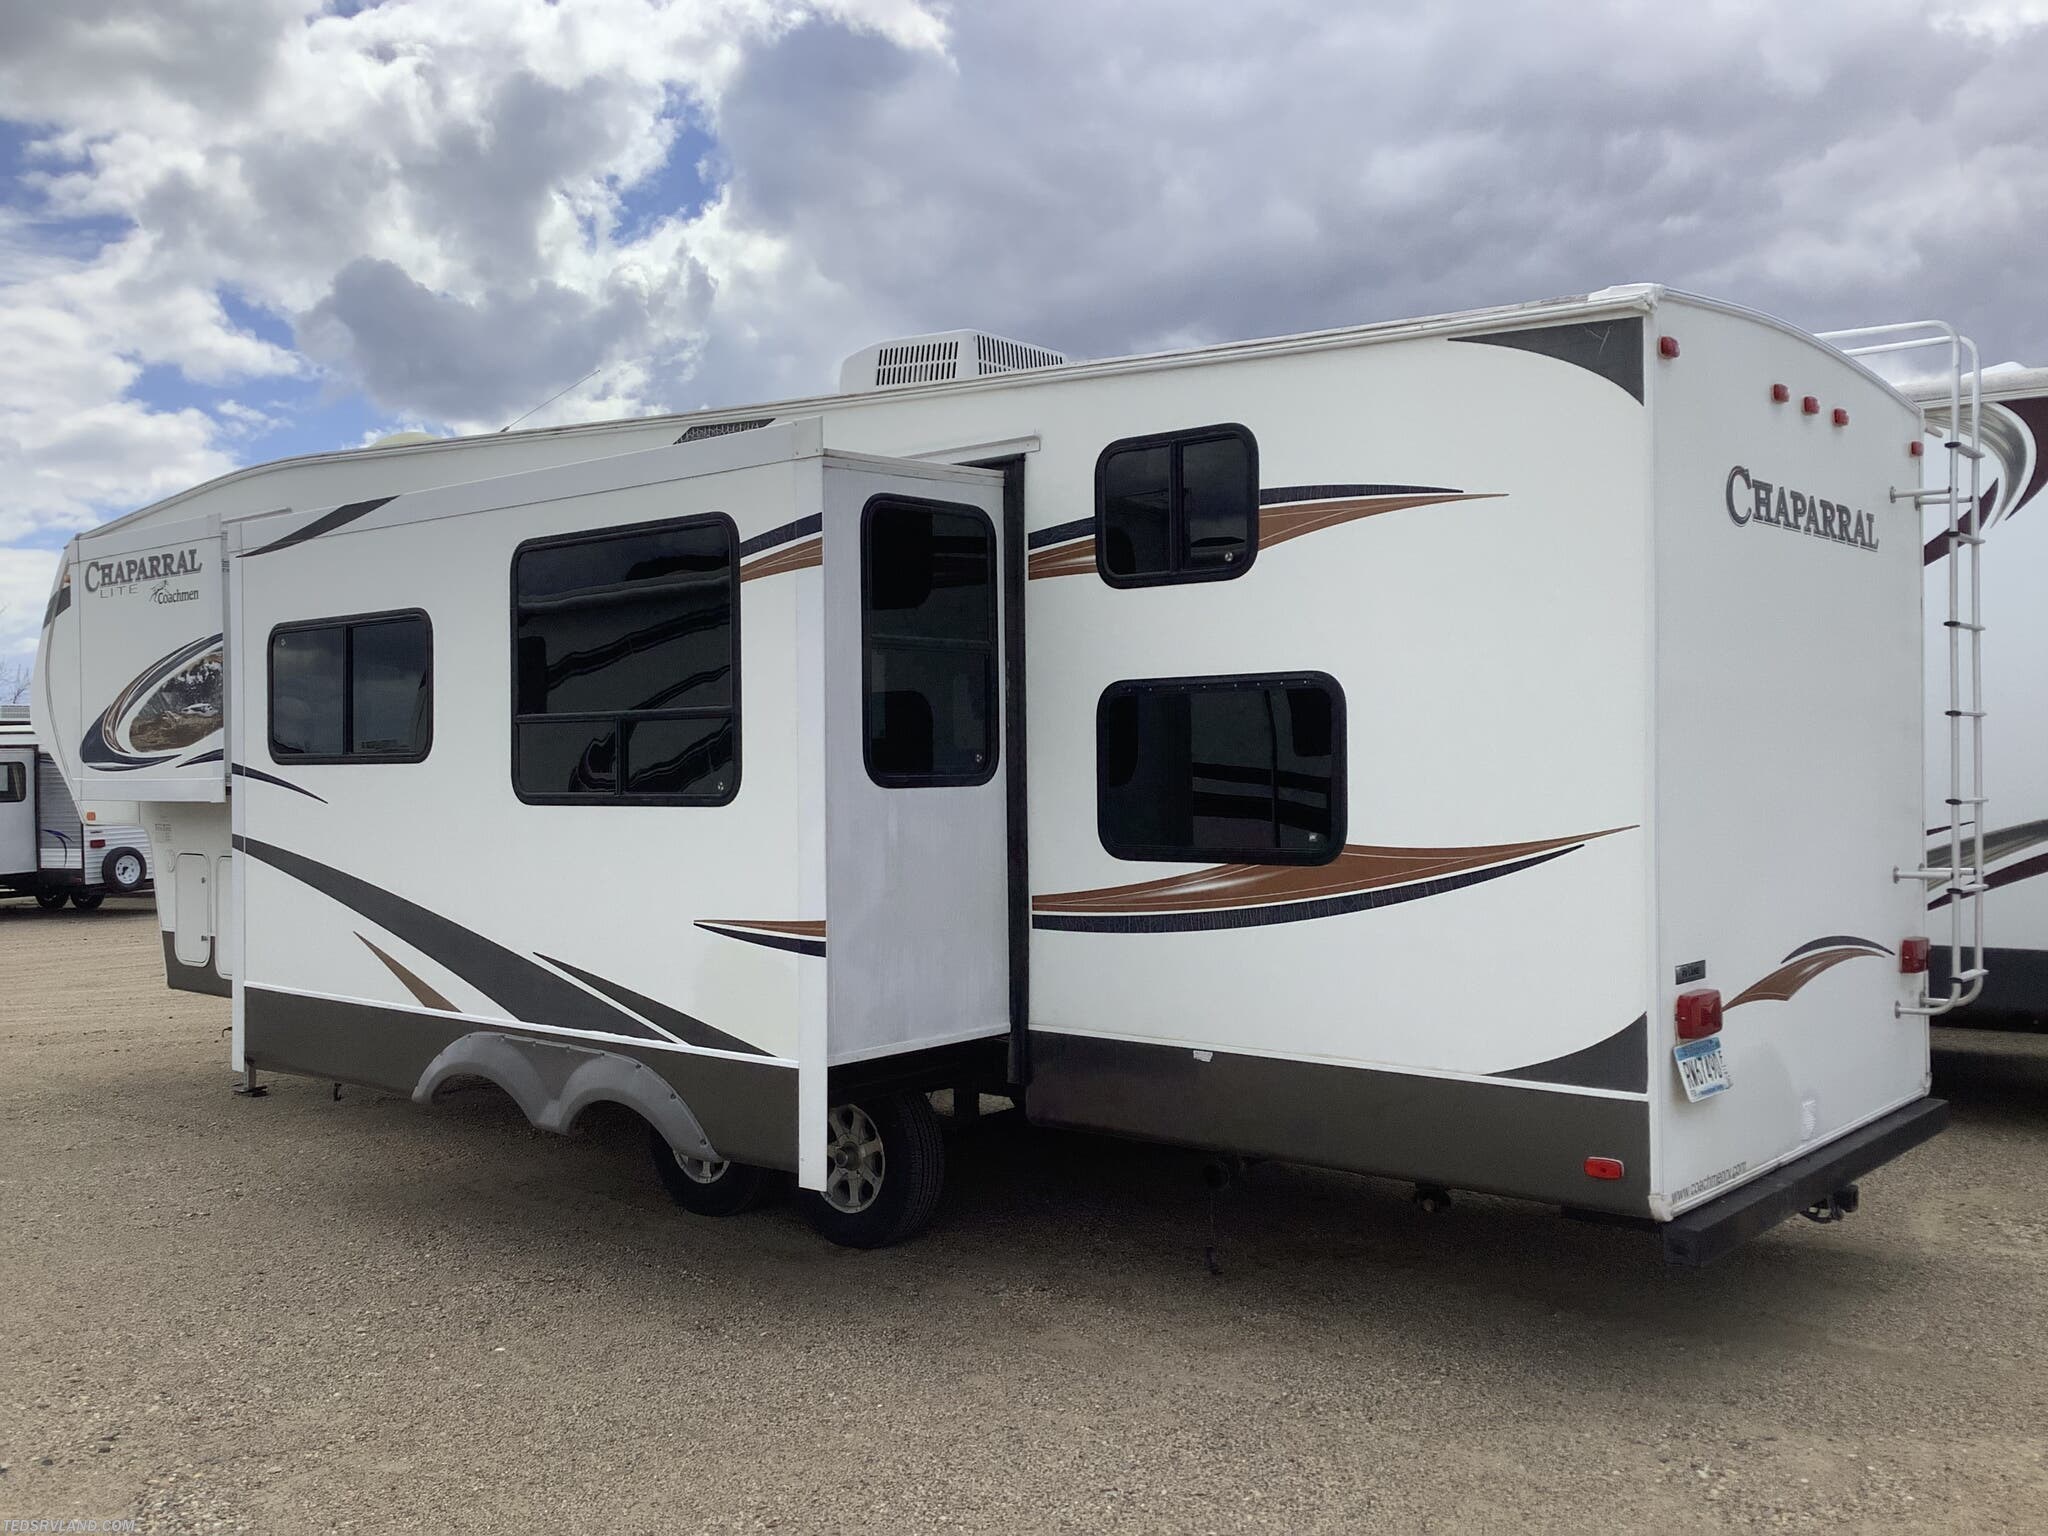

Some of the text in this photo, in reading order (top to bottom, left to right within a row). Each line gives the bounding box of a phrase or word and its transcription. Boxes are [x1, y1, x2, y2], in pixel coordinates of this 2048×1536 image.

[1726, 465, 1879, 552] CHAPARRAL
[85, 549, 203, 592] CHAPARRAL
[100, 583, 138, 598] LITE
[158, 589, 199, 604] Coachmen
